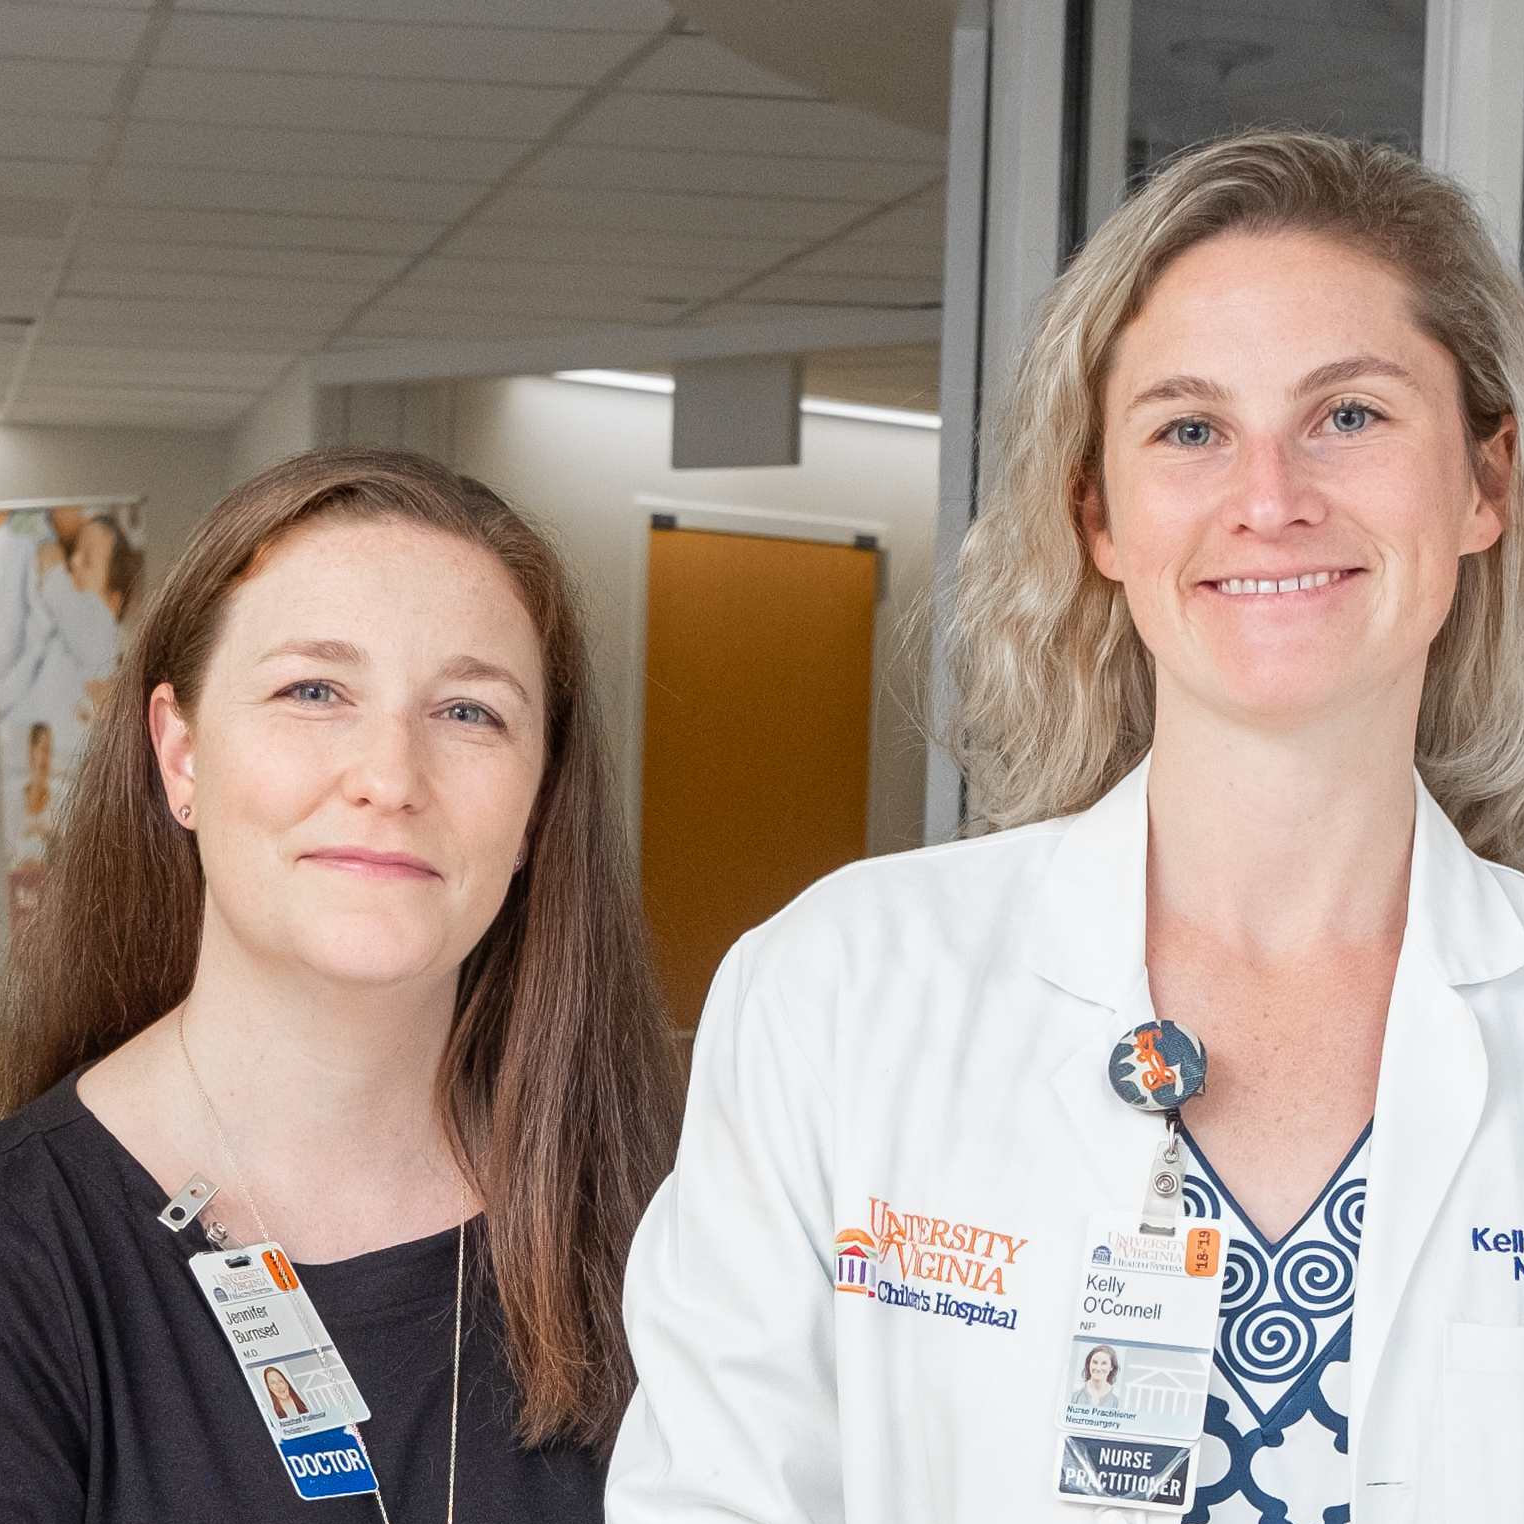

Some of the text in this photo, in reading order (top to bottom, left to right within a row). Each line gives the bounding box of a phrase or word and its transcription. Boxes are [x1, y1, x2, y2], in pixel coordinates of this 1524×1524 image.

[1108, 1231, 1186, 1251] UNIVERSITY
[1120, 1246, 1182, 1263] VIRGINIA
[1087, 1274, 1125, 1297] Kelly
[226, 1305, 269, 1326] Jennifer
[934, 1292, 1017, 1330] Hospital
[1084, 1296, 1161, 1319] O'Connell
[232, 1322, 279, 1344] Burnsed
[1080, 1321, 1096, 1331] NP
[288, 1449, 366, 1478] DOCTOR
[1099, 1448, 1153, 1470] NURSE
